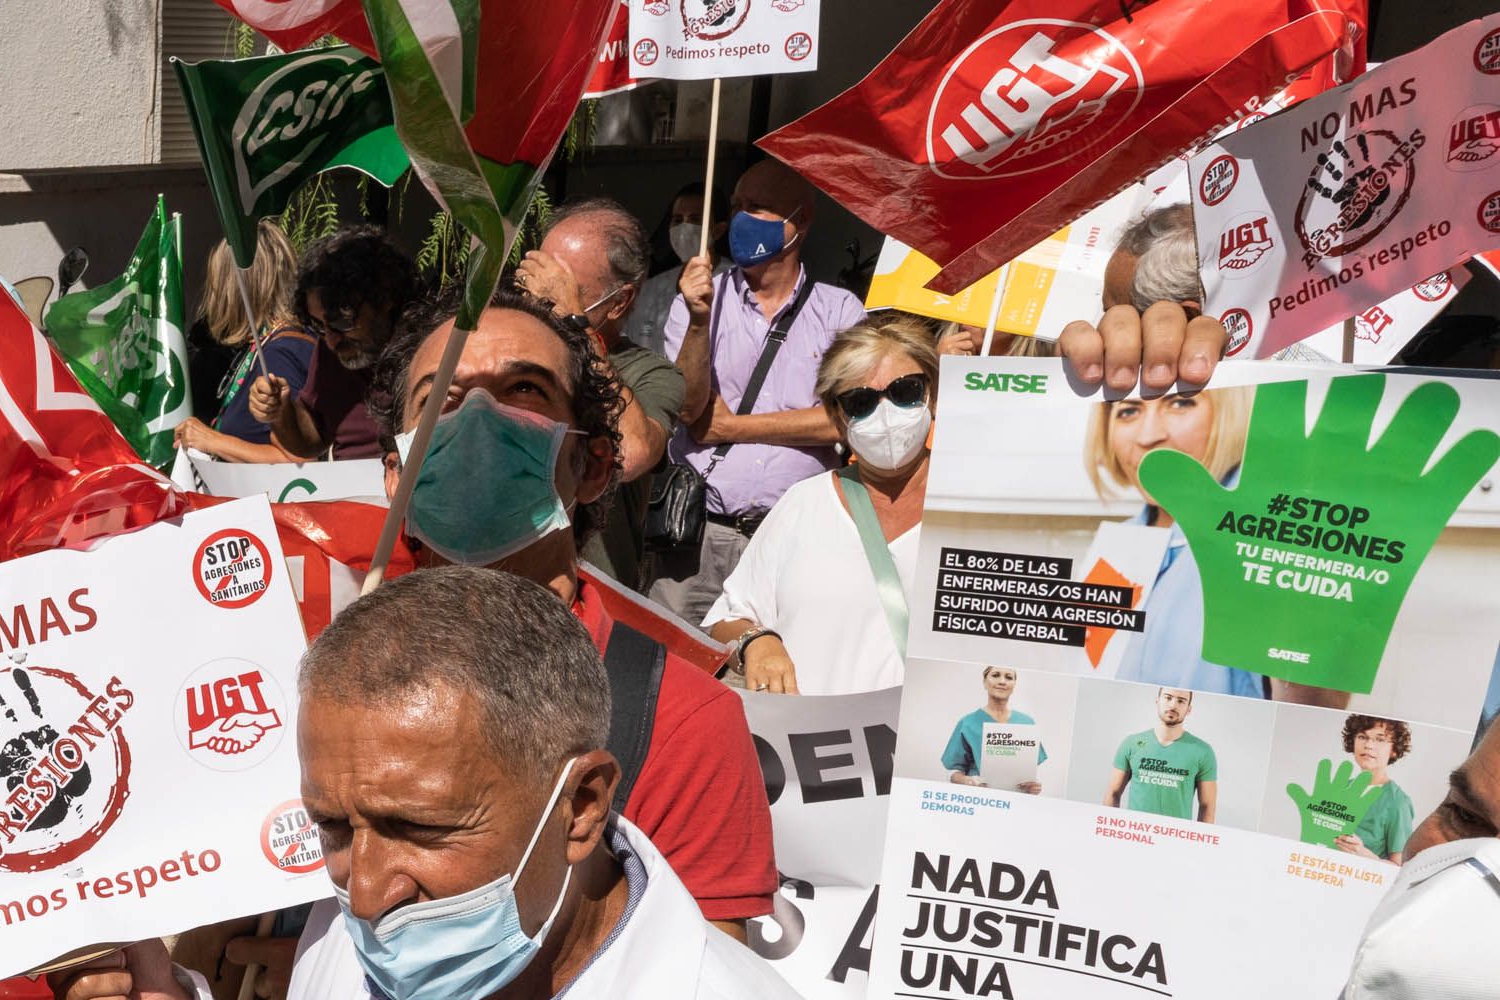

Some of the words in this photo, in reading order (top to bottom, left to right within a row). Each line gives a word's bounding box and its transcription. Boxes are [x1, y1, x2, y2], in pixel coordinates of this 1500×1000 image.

[666, 46, 716, 60] Pedimos
[718, 42, 771, 61] respeto
[941, 32, 1097, 167] UGT
[1300, 111, 1342, 153] NO
[1348, 78, 1417, 128] MAS
[1206, 159, 1231, 182] STOP
[1300, 128, 1427, 272] AGRESIONES
[1220, 216, 1269, 259] UGT
[1268, 262, 1364, 319] Pedimos
[1367, 218, 1452, 268] respeto
[964, 372, 1049, 394] SATSE
[1267, 493, 1370, 529] #STOP
[204, 537, 251, 566] STOP
[1216, 511, 1406, 564] AGRESIONES
[204, 557, 262, 581] AGRESIONES
[944, 553, 964, 568] EL
[967, 555, 999, 571] 80%
[1002, 559, 1025, 573] DE
[1027, 562, 1059, 577] LAS
[1236, 542, 1259, 558] TU
[1261, 547, 1390, 585] ENFERMERA/O
[211, 580, 266, 602] SANITARIOS
[942, 574, 1082, 600] ENFERMERAS/OS
[1085, 588, 1122, 605] HAN
[1242, 561, 1274, 586] TE
[1275, 569, 1353, 602] CUIDA
[939, 595, 1010, 614] SUFRIDO
[1012, 602, 1048, 618] UNA
[1051, 604, 1136, 628] AGRESIÓN
[938, 613, 987, 634] FÍSICA
[990, 620, 1003, 634] O
[1005, 622, 1069, 642] VERBAL
[1268, 647, 1311, 664] SATSE
[186, 670, 269, 732] UGT
[986, 732, 1013, 741] #STOP
[986, 739, 1036, 748] AGRESIONES
[1138, 763, 1190, 776] AGRESIONES
[921, 801, 975, 816] DEMORAS
[922, 790, 933, 799] SI
[934, 792, 948, 801] SE
[950, 794, 1011, 810] PRODUCEN
[1306, 803, 1356, 823] AGRESIONES
[273, 809, 308, 835] STO
[1095, 827, 1155, 845] PERSONAL
[1096, 815, 1107, 825] SI
[1109, 818, 1126, 828] NO
[1128, 821, 1152, 832] HAY
[1153, 825, 1220, 845] SUFICIENTE
[272, 829, 319, 849] AGRESION
[278, 848, 322, 868] SANITARI
[1289, 852, 1301, 862] SI
[1338, 865, 1353, 877] EN
[1354, 870, 1384, 885] LISTA
[76, 848, 223, 900] respeto
[911, 851, 1060, 910] NADA
[1287, 864, 1302, 877] DE
[1304, 869, 1344, 888] ESPERA
[902, 901, 1168, 986] JUSTIFICA
[900, 949, 1014, 1000] UNA
